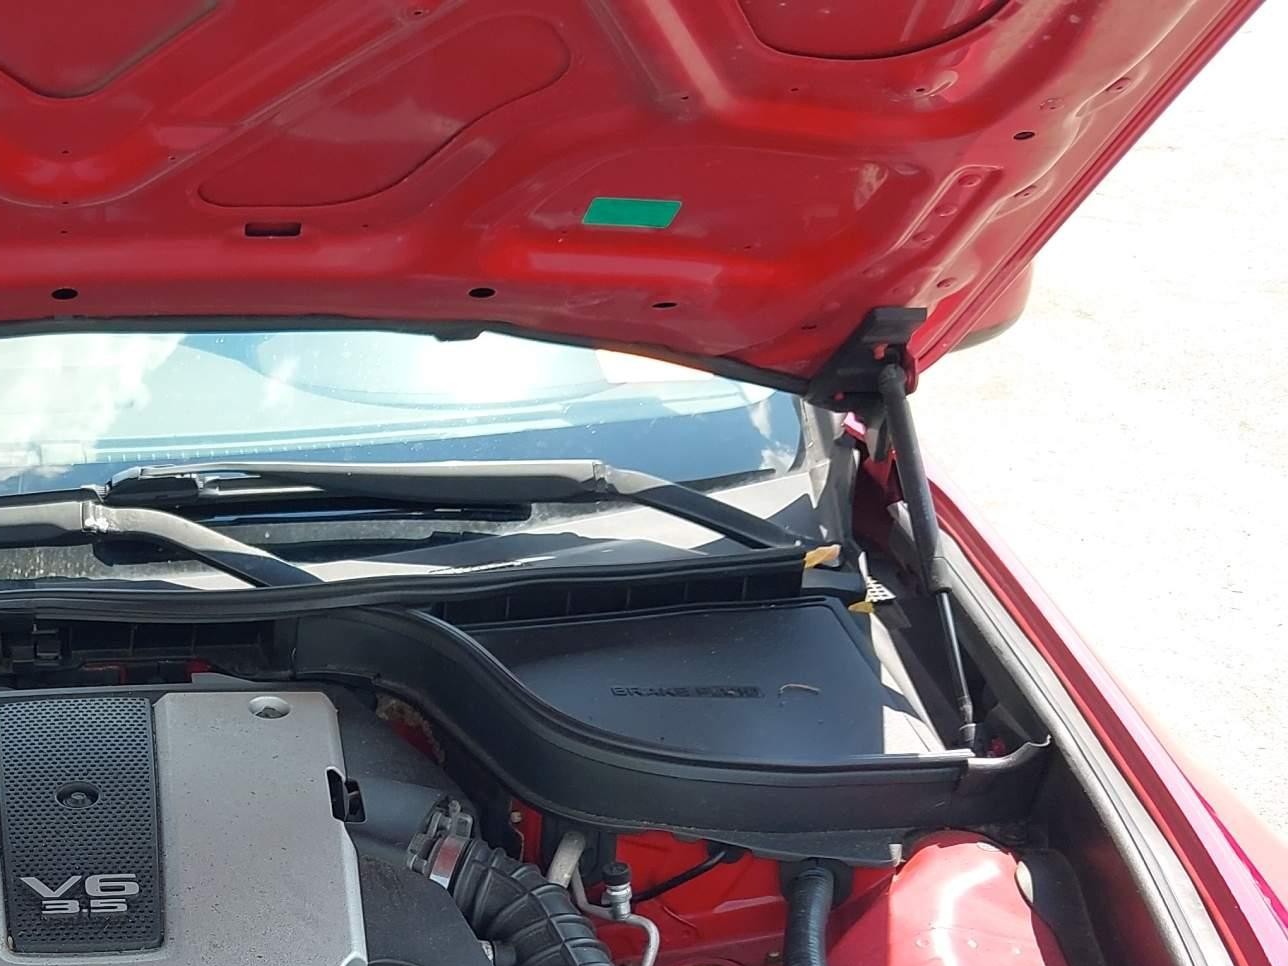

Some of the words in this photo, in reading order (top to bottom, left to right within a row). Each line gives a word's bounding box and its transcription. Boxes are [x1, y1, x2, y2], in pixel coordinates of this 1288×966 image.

[610, 686, 690, 697] BRAKE
[19, 873, 140, 898] V6
[41, 898, 128, 915] 3.5
